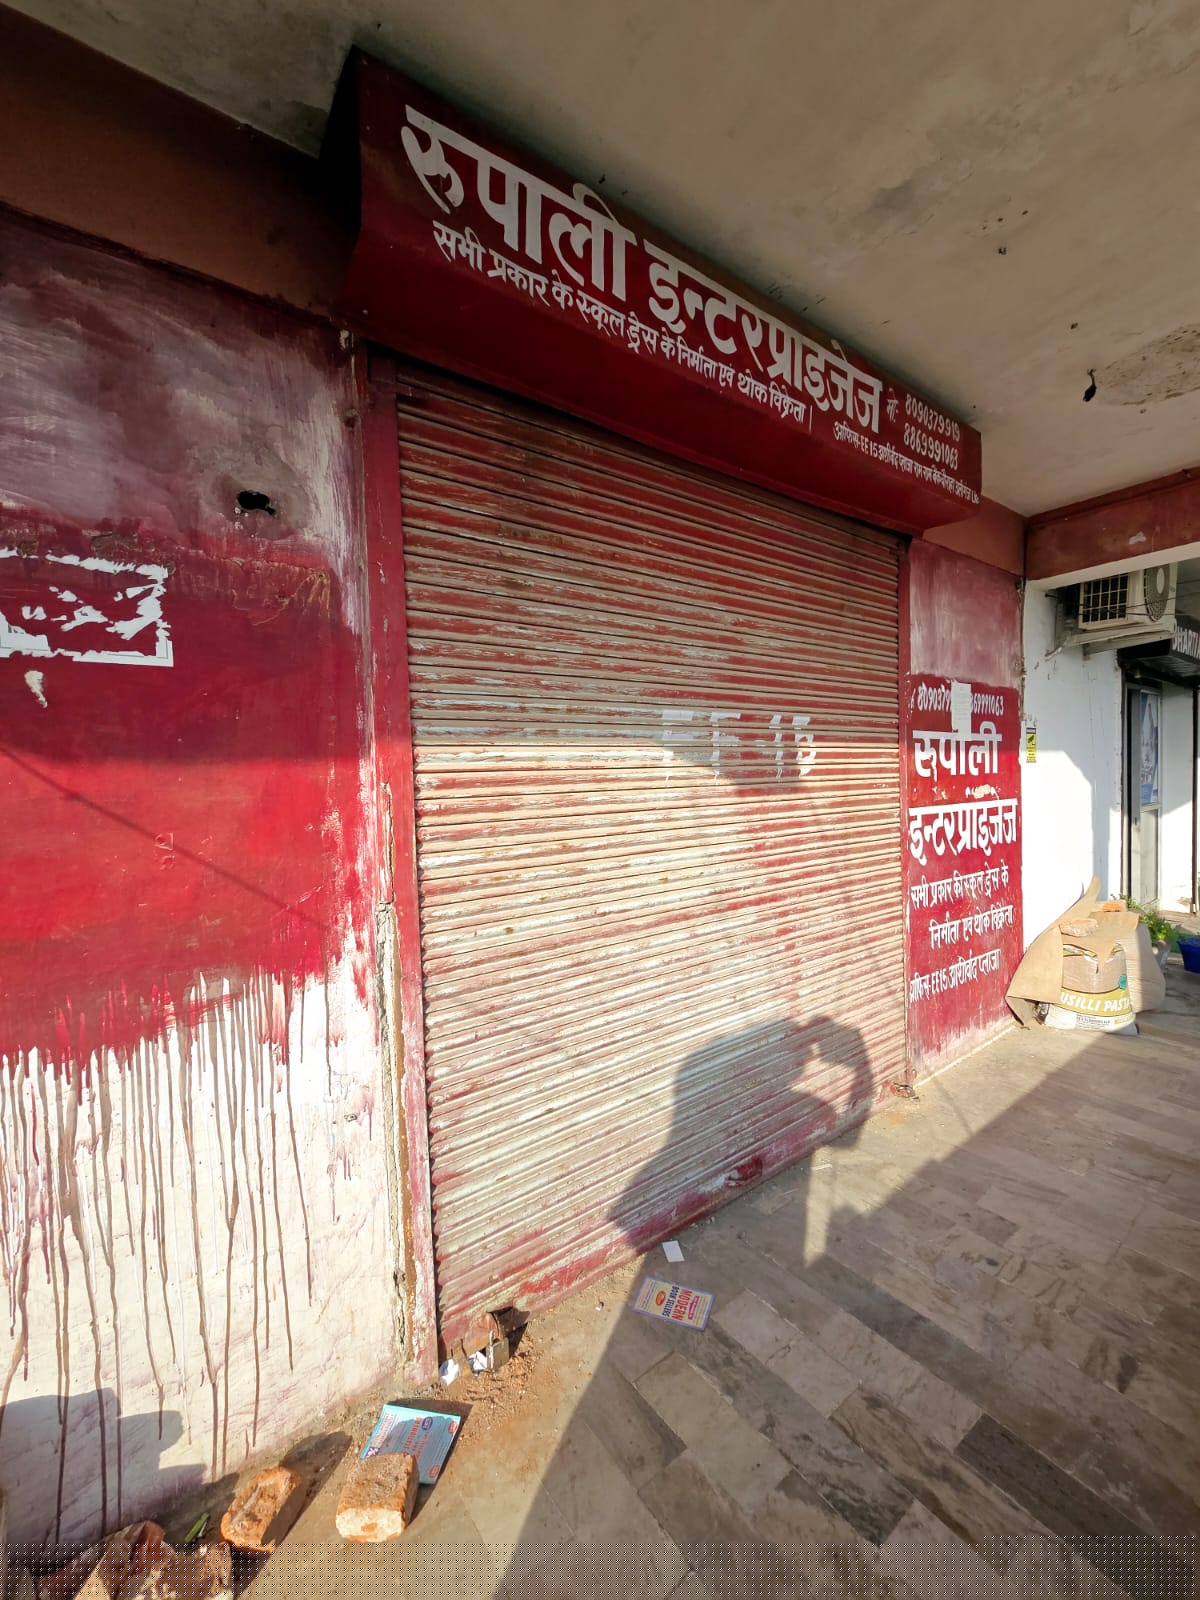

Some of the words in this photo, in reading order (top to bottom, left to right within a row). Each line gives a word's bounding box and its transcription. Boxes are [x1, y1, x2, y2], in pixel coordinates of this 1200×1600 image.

[433, 220, 487, 273] सभी
[487, 248, 550, 307] प्रकार
[551, 269, 573, 310] के
[576, 289, 626, 336] स्कूल
[627, 311, 659, 355] ड्रेस
[660, 327, 676, 360] के
[676, 336, 718, 380] निर्माता
[718, 363, 735, 389] एवं
[737, 369, 768, 404] थोक
[905, 393, 960, 442] 8090379919
[904, 422, 958, 471] 8869991063
[910, 874, 929, 911] सभी
[929, 878, 954, 907] प्रकार
[1000, 859, 1009, 888] के
[928, 911, 961, 950] निर्माता
[1060, 992, 1101, 1013] USILLI
[671, 1288, 693, 1321] MODERN
